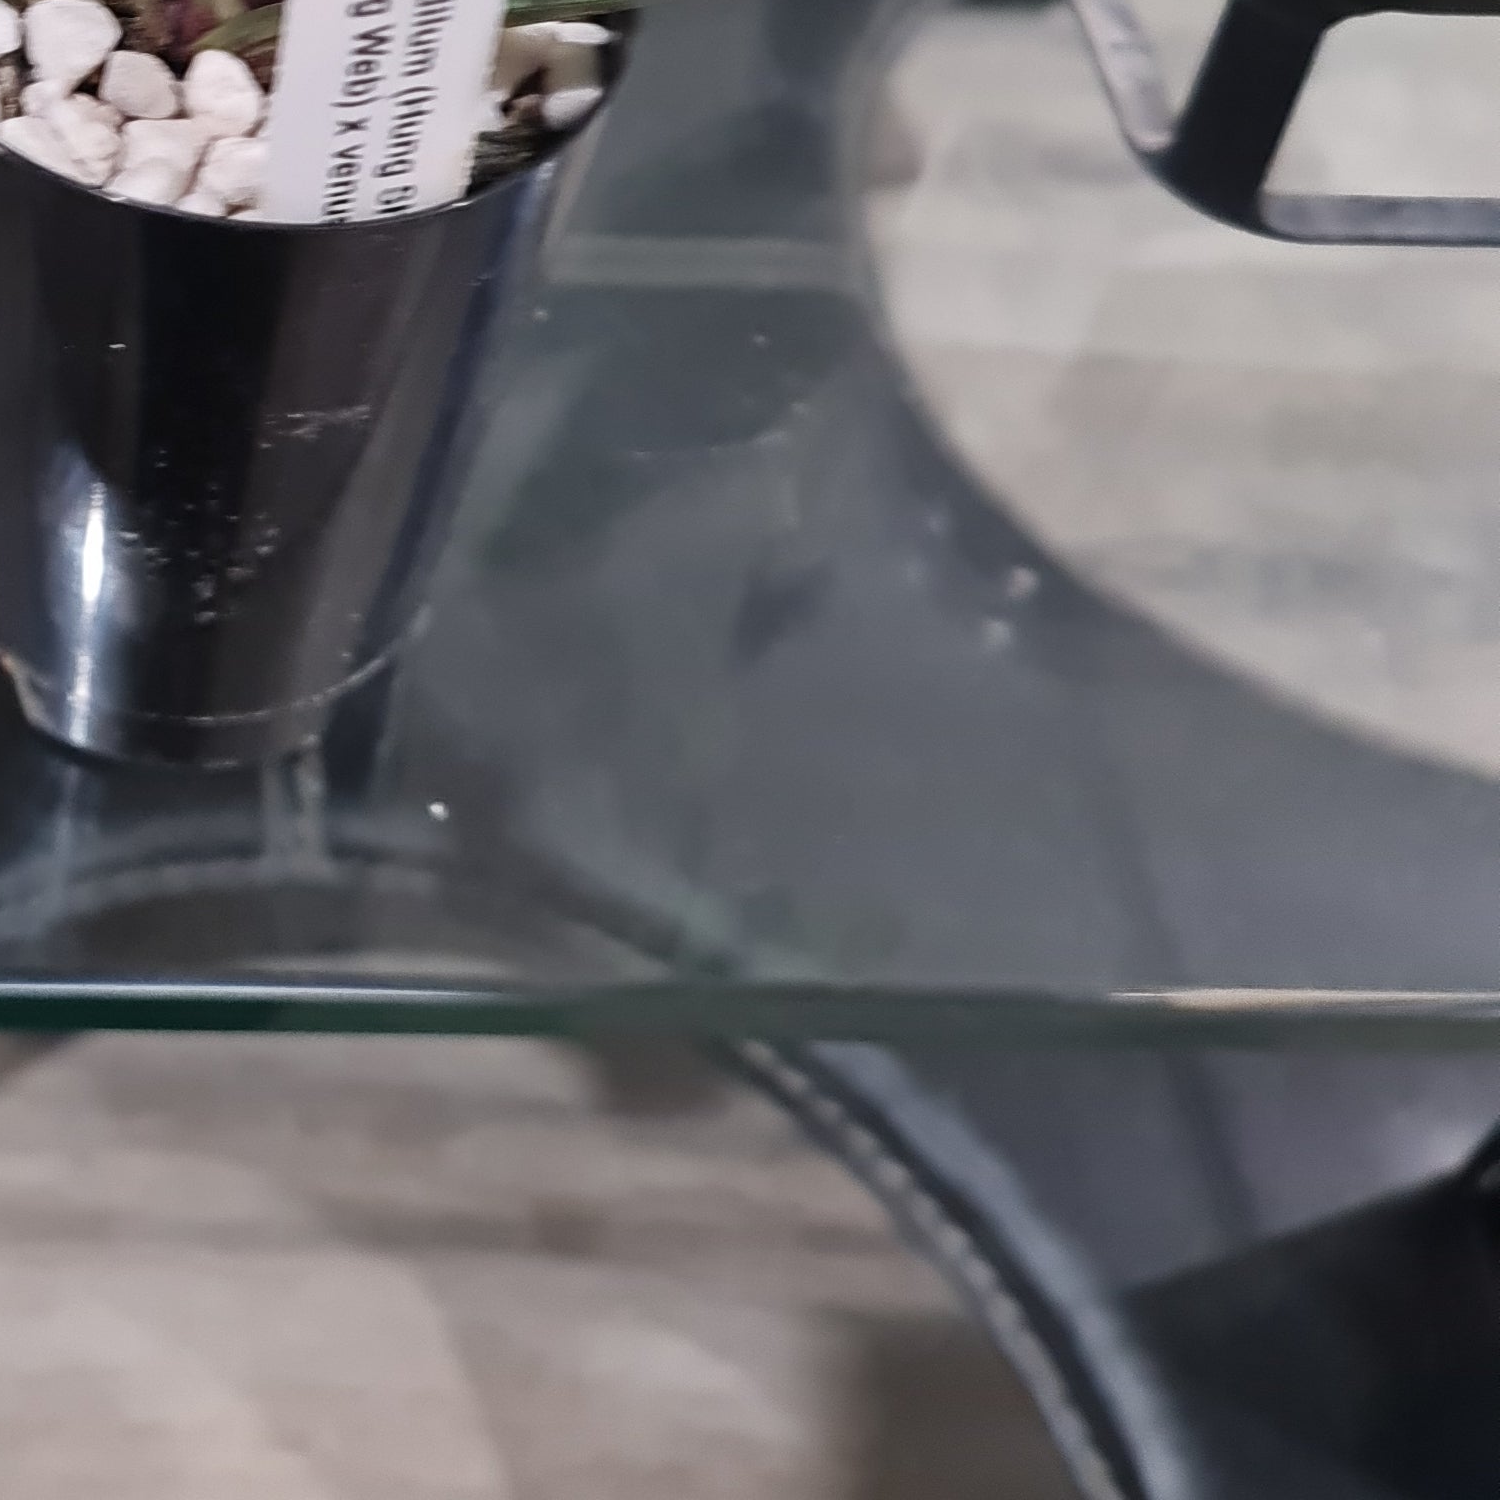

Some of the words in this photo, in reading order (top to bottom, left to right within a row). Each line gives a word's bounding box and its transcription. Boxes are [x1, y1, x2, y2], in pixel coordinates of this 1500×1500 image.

[329, 24, 396, 108] Web)
[334, 117, 370, 137] x
[370, 86, 440, 179] (Hung
